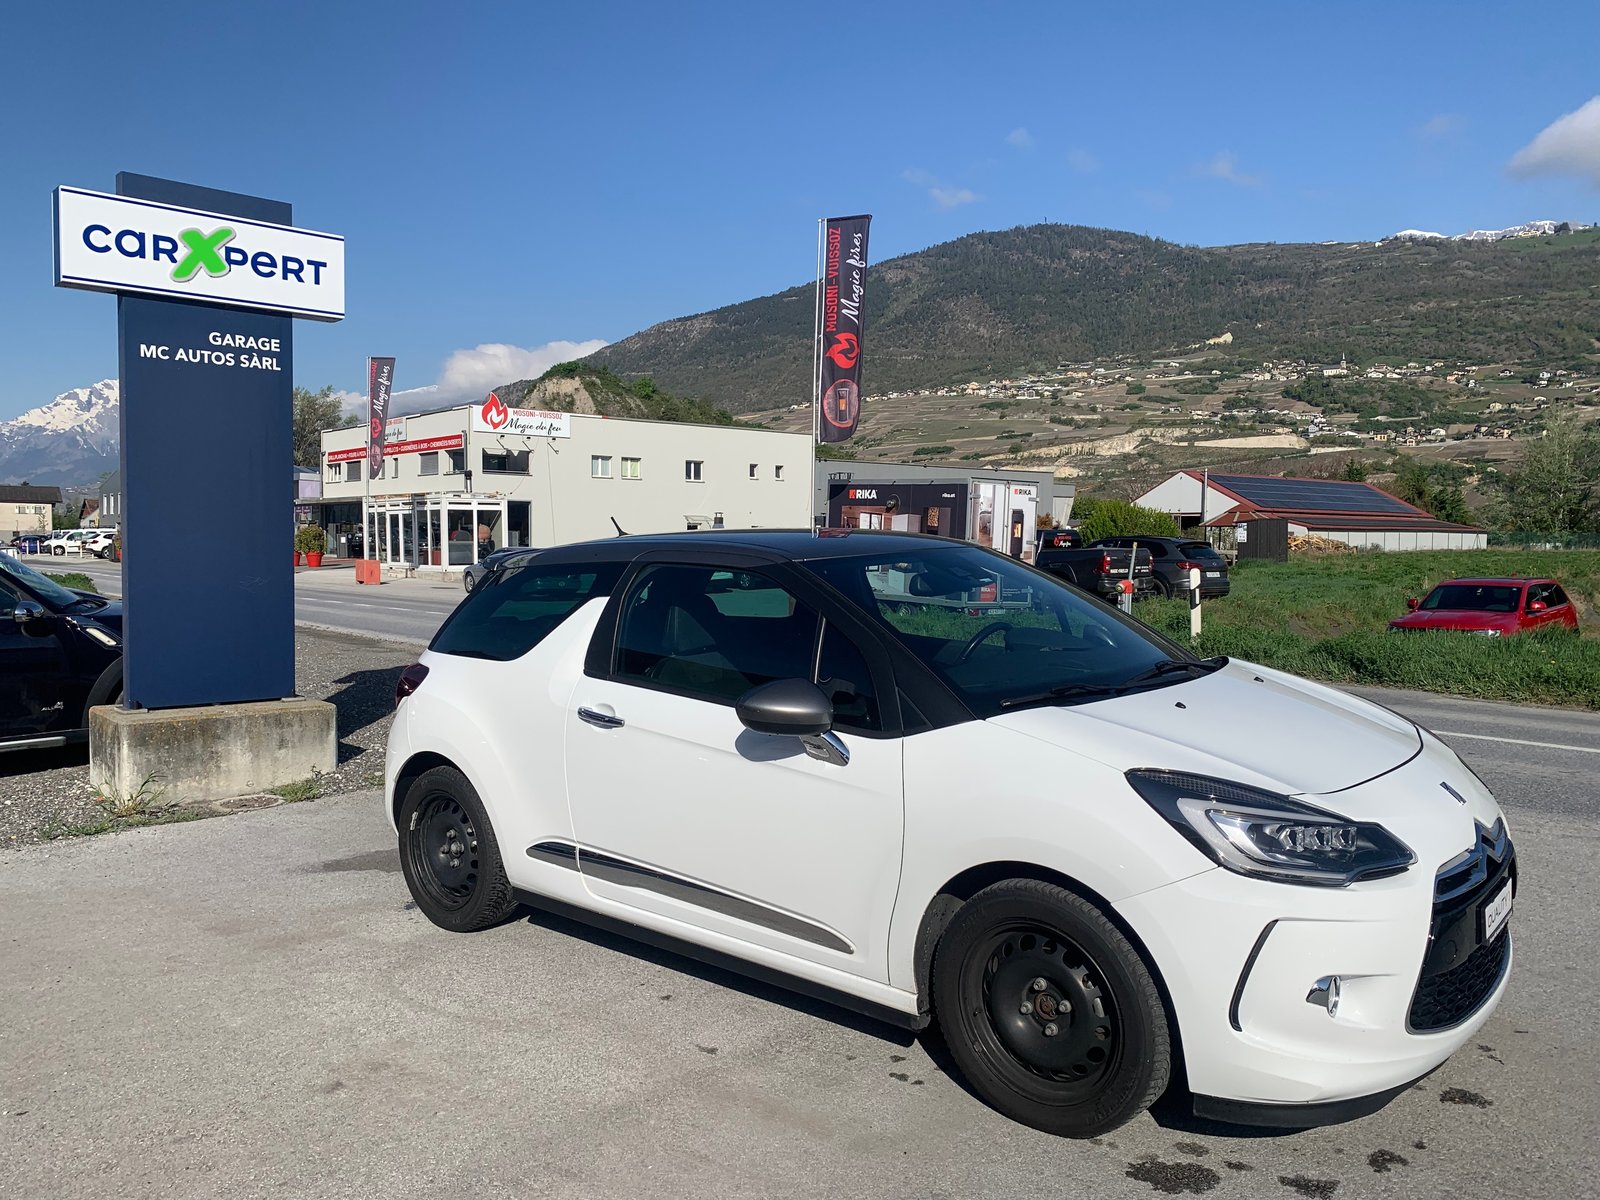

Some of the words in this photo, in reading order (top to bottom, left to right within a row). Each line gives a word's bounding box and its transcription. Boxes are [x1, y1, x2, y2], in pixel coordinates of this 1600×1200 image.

[846, 232, 866, 268] fires
[826, 227, 841, 332] MOSONI-VUISSOZ
[840, 269, 864, 325] Magic
[208, 331, 281, 352] GARAGE
[139, 343, 170, 360] MC
[175, 347, 235, 366] AUTOS
[512, 409, 563, 420] MOSONI-VUISSOZ
[502, 417, 534, 434] Magie
[536, 421, 547, 431] du
[547, 422, 562, 435] feu
[855, 489, 877, 499] RIKA
